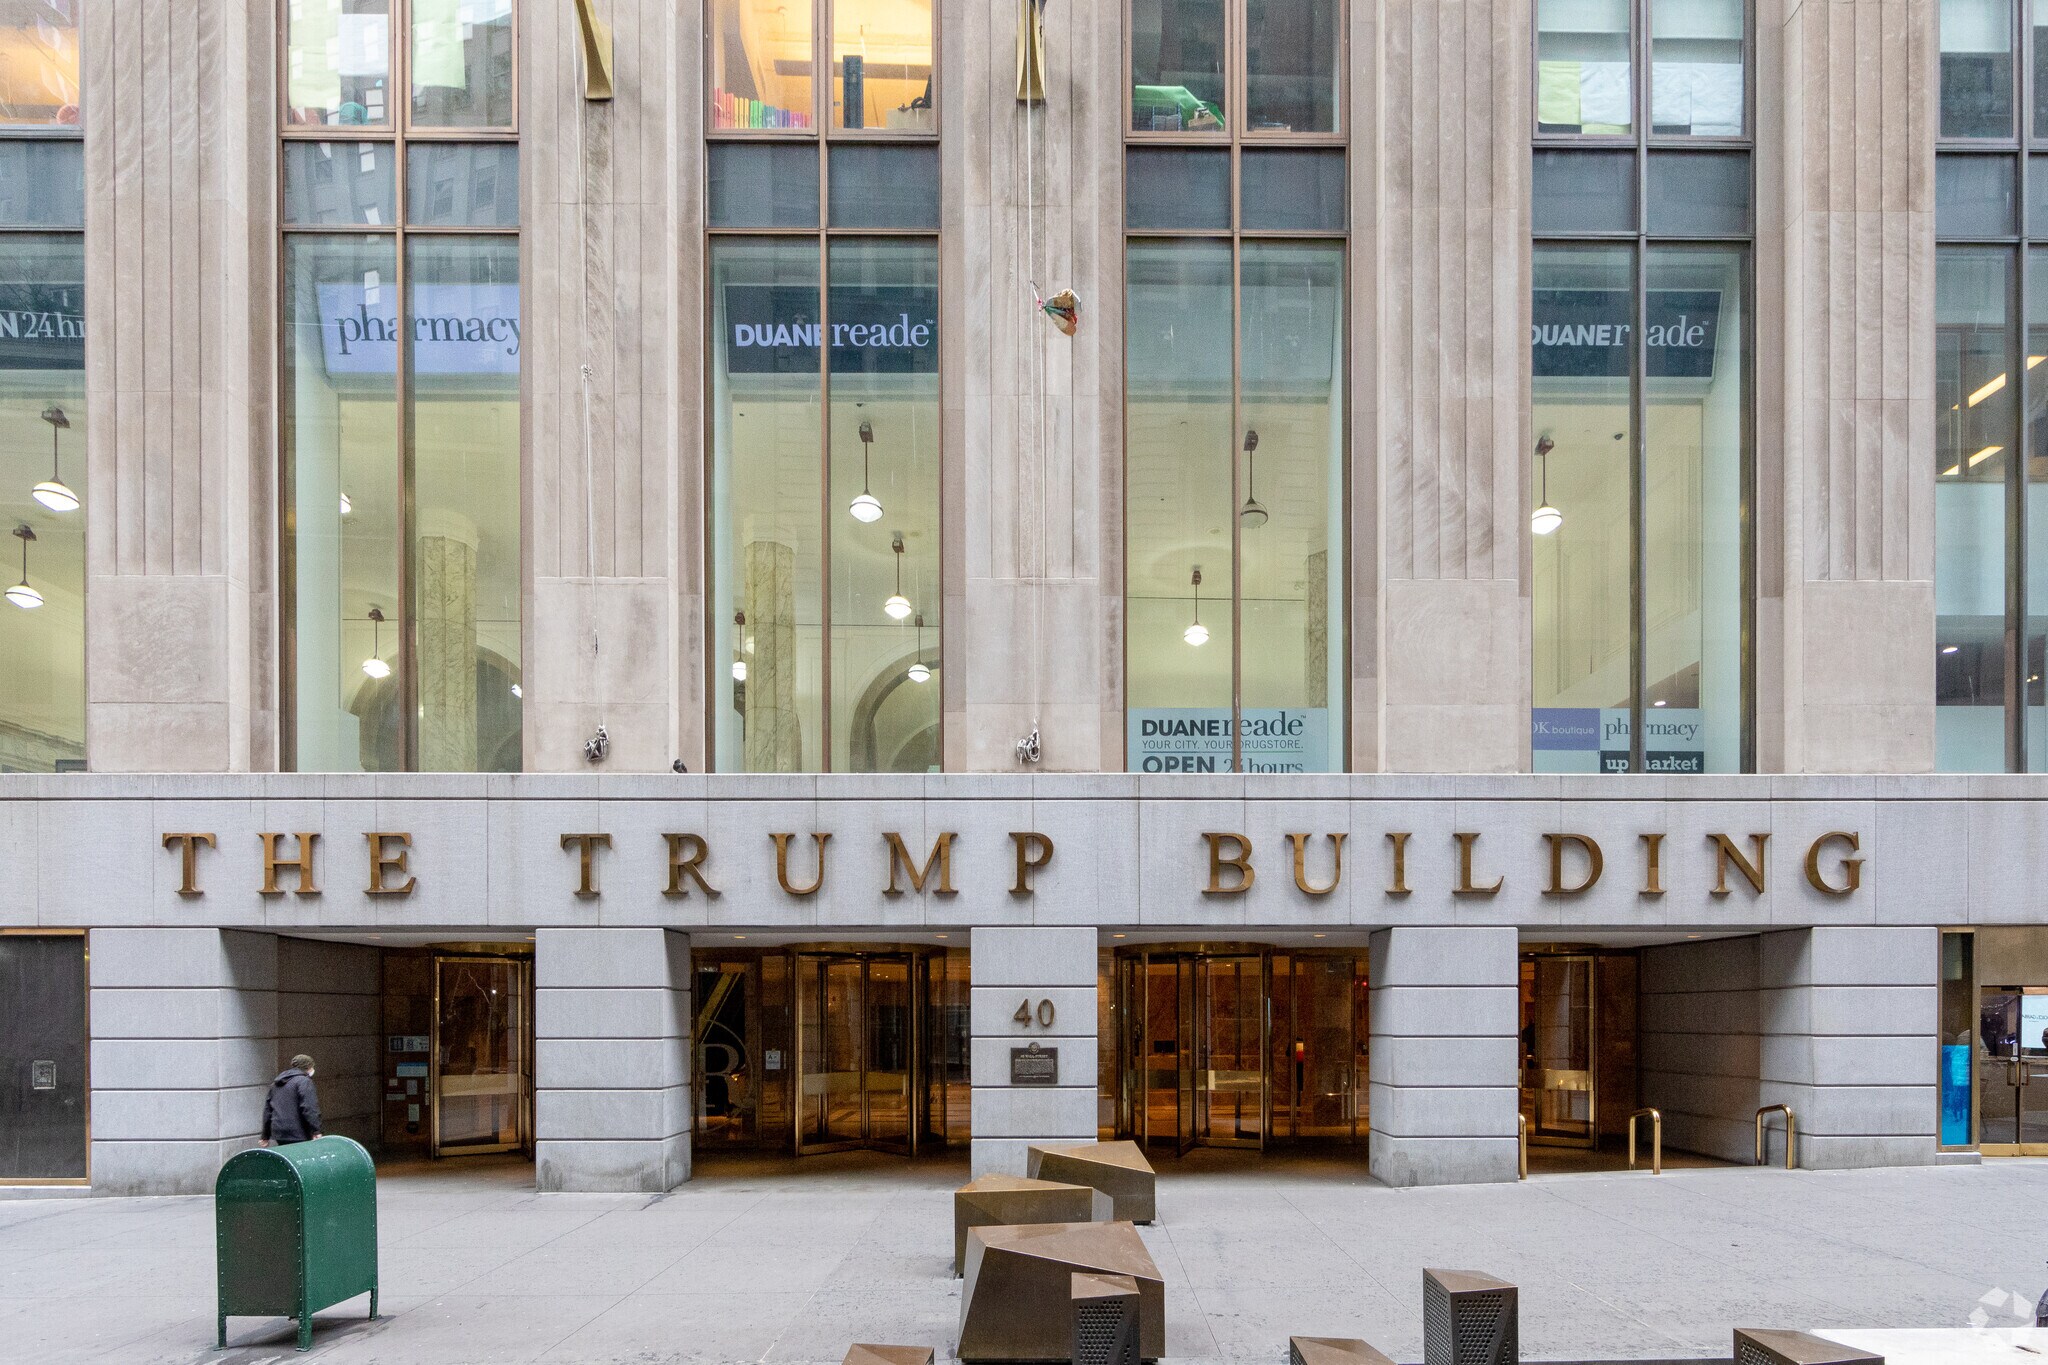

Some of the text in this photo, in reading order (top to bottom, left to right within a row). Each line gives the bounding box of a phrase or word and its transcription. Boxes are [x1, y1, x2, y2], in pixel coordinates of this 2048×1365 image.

[1612, 315, 1704, 347] rade
[1141, 719, 1220, 737] DUANE
[1552, 725, 1595, 736] boutique
[1604, 717, 1699, 742] phmacy
[1142, 740, 1171, 750] YOUR
[1142, 755, 1216, 773] OPEN
[1645, 756, 1698, 771] arket
[161, 831, 1867, 897] THE TRUMP BUILDING
[1013, 998, 1055, 1028] 40
